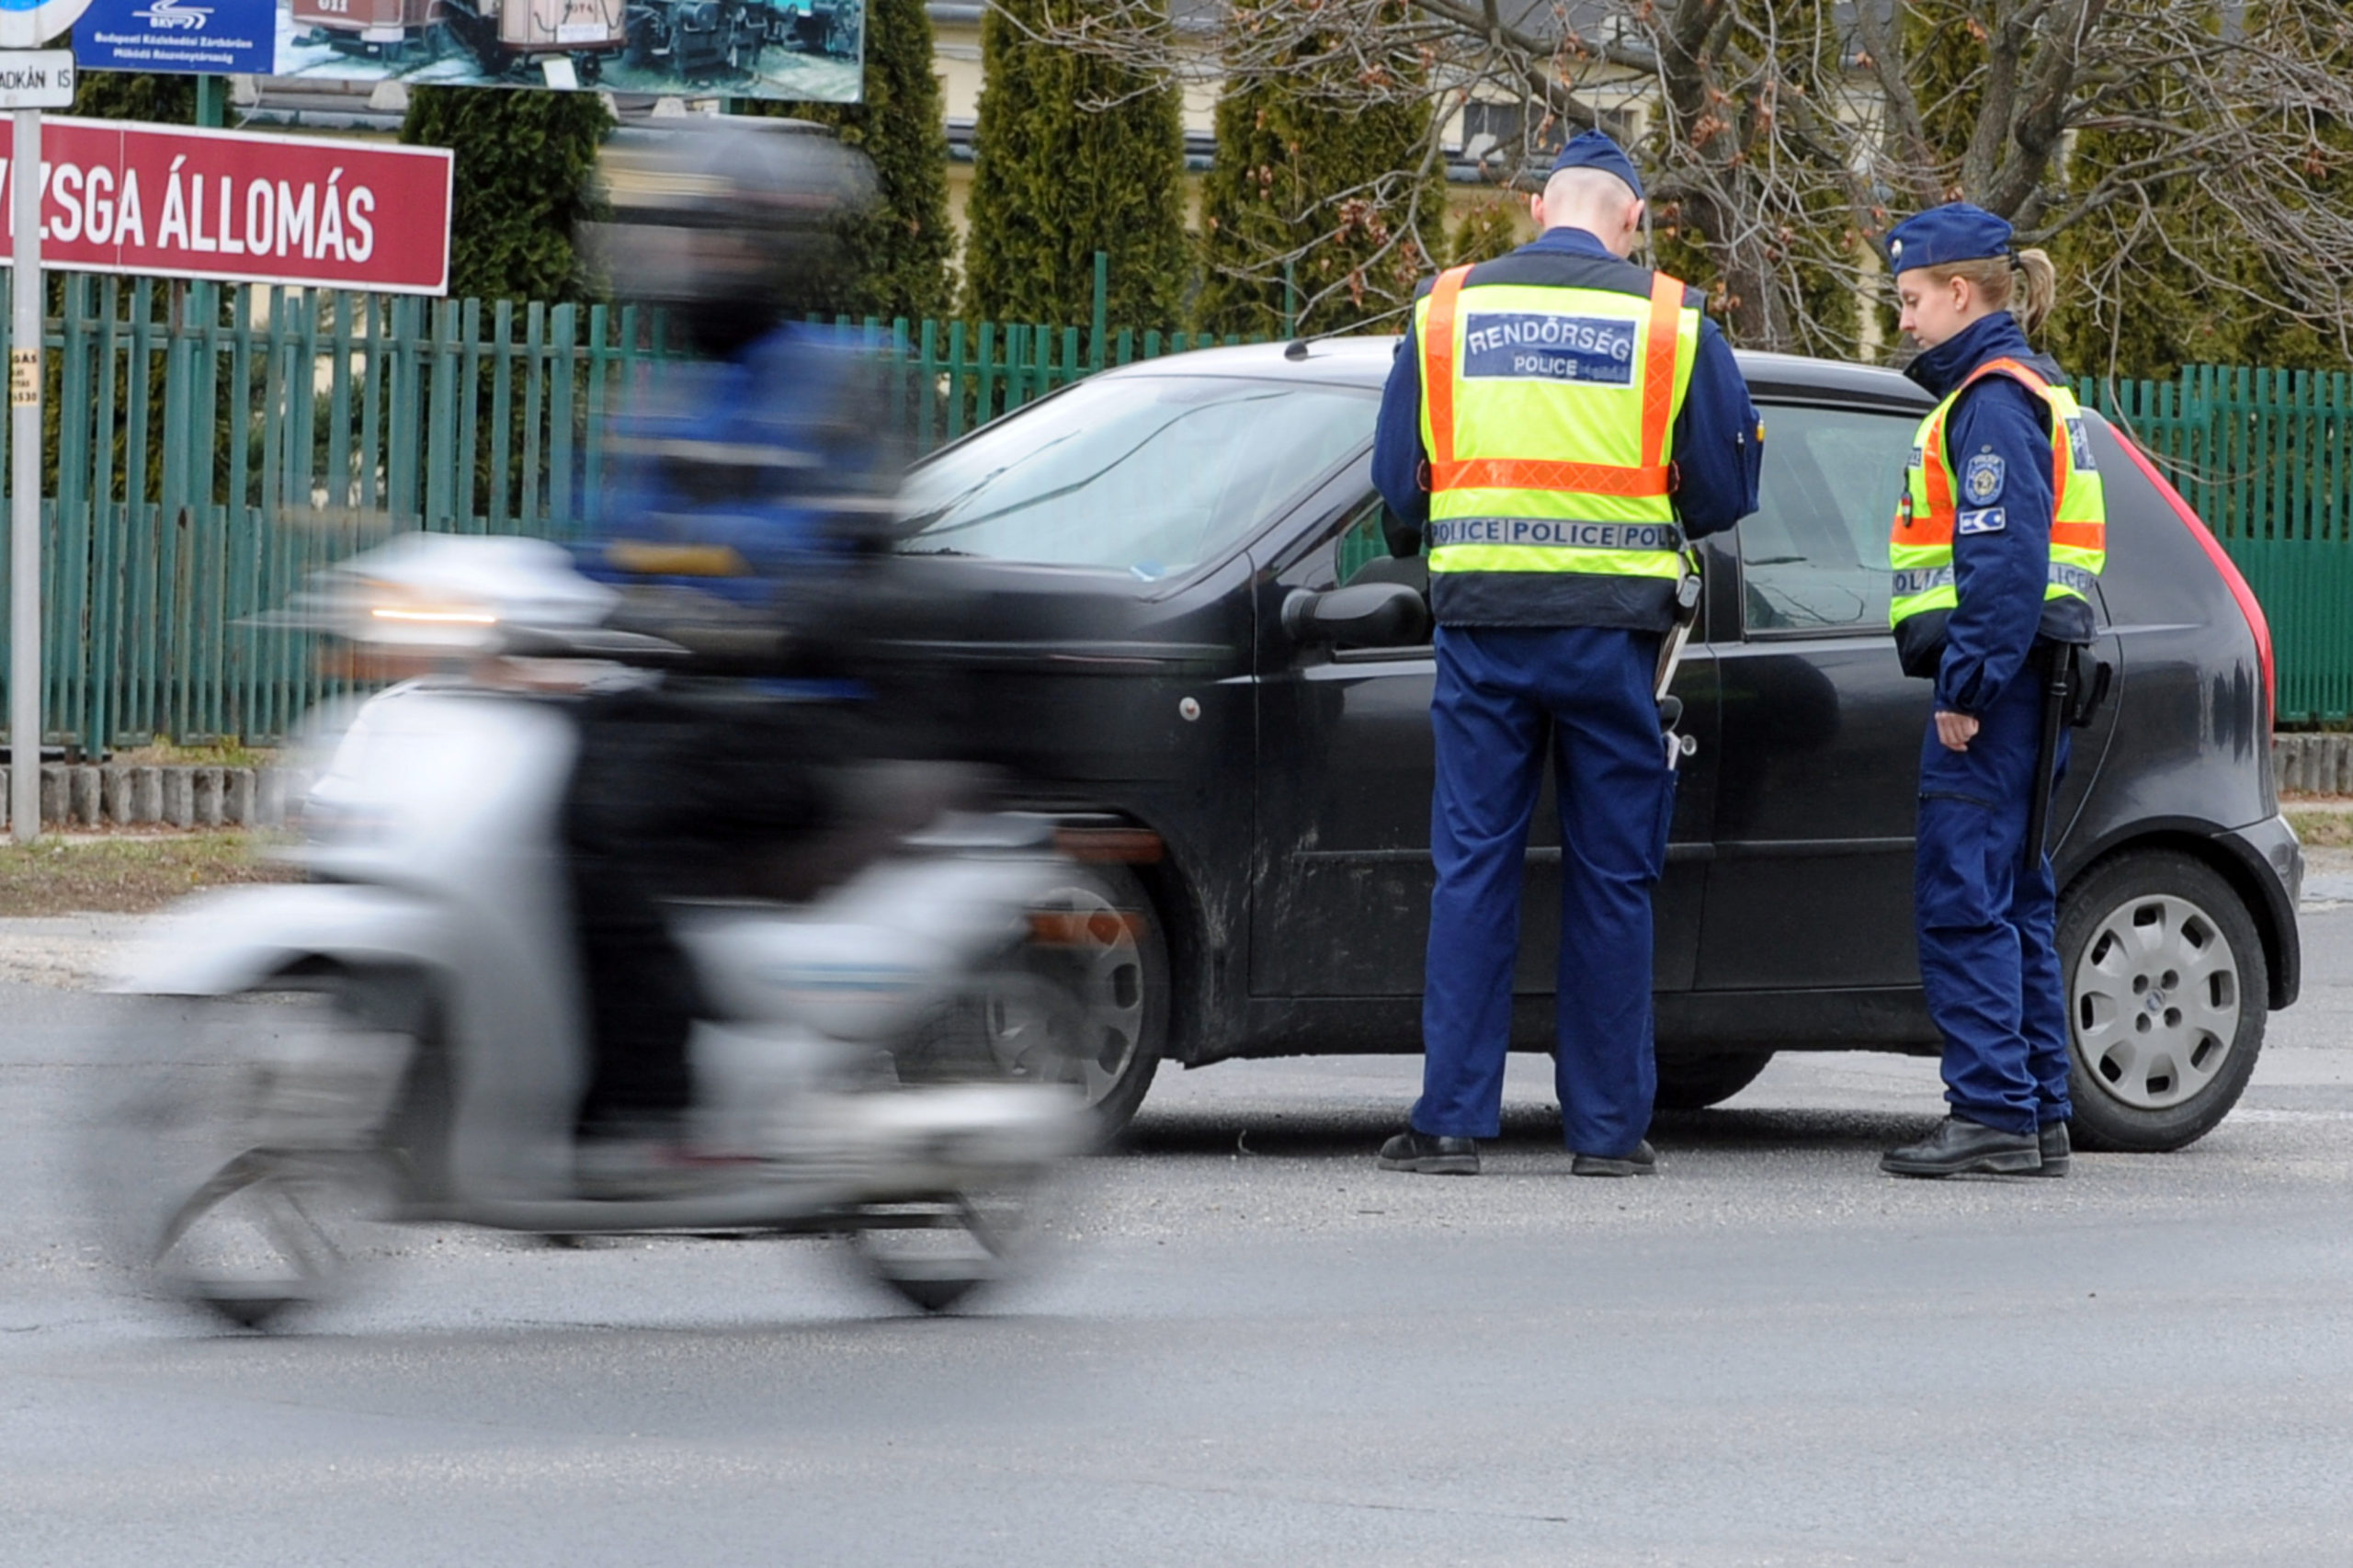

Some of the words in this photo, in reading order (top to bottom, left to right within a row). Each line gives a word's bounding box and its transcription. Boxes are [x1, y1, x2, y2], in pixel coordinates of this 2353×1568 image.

[57, 69, 71, 88] IS
[156, 153, 375, 264] ÁLLOMÁS
[1469, 317, 1631, 363] RENDŐRSÉG
[1514, 355, 1578, 377] POLICE
[1513, 522, 1615, 546] POLICE
[1625, 527, 1666, 547] POL
